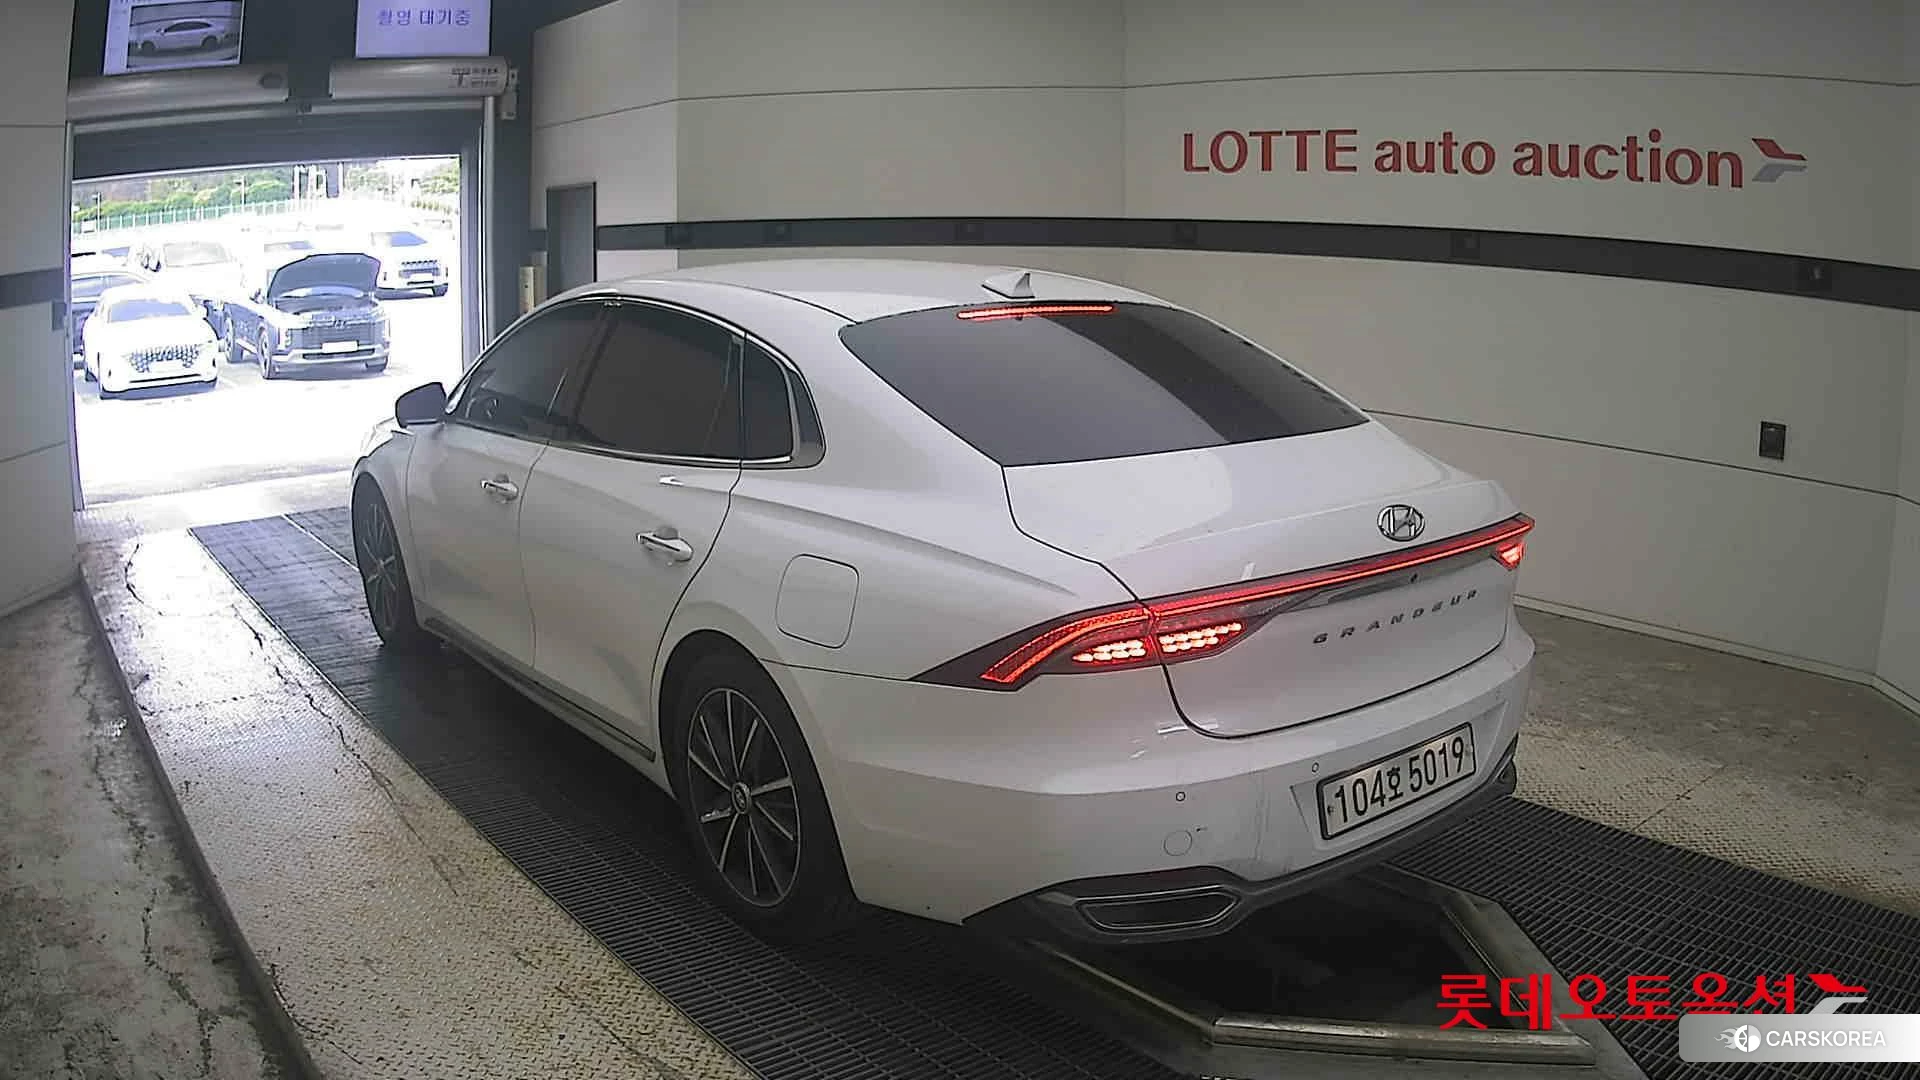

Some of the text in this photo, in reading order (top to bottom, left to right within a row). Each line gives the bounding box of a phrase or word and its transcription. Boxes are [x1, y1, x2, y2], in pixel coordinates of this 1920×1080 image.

[1183, 128, 1743, 189] LOTTE auto auction
[1312, 589, 1478, 645] GRANDEUR
[1407, 735, 1466, 793] 5019
